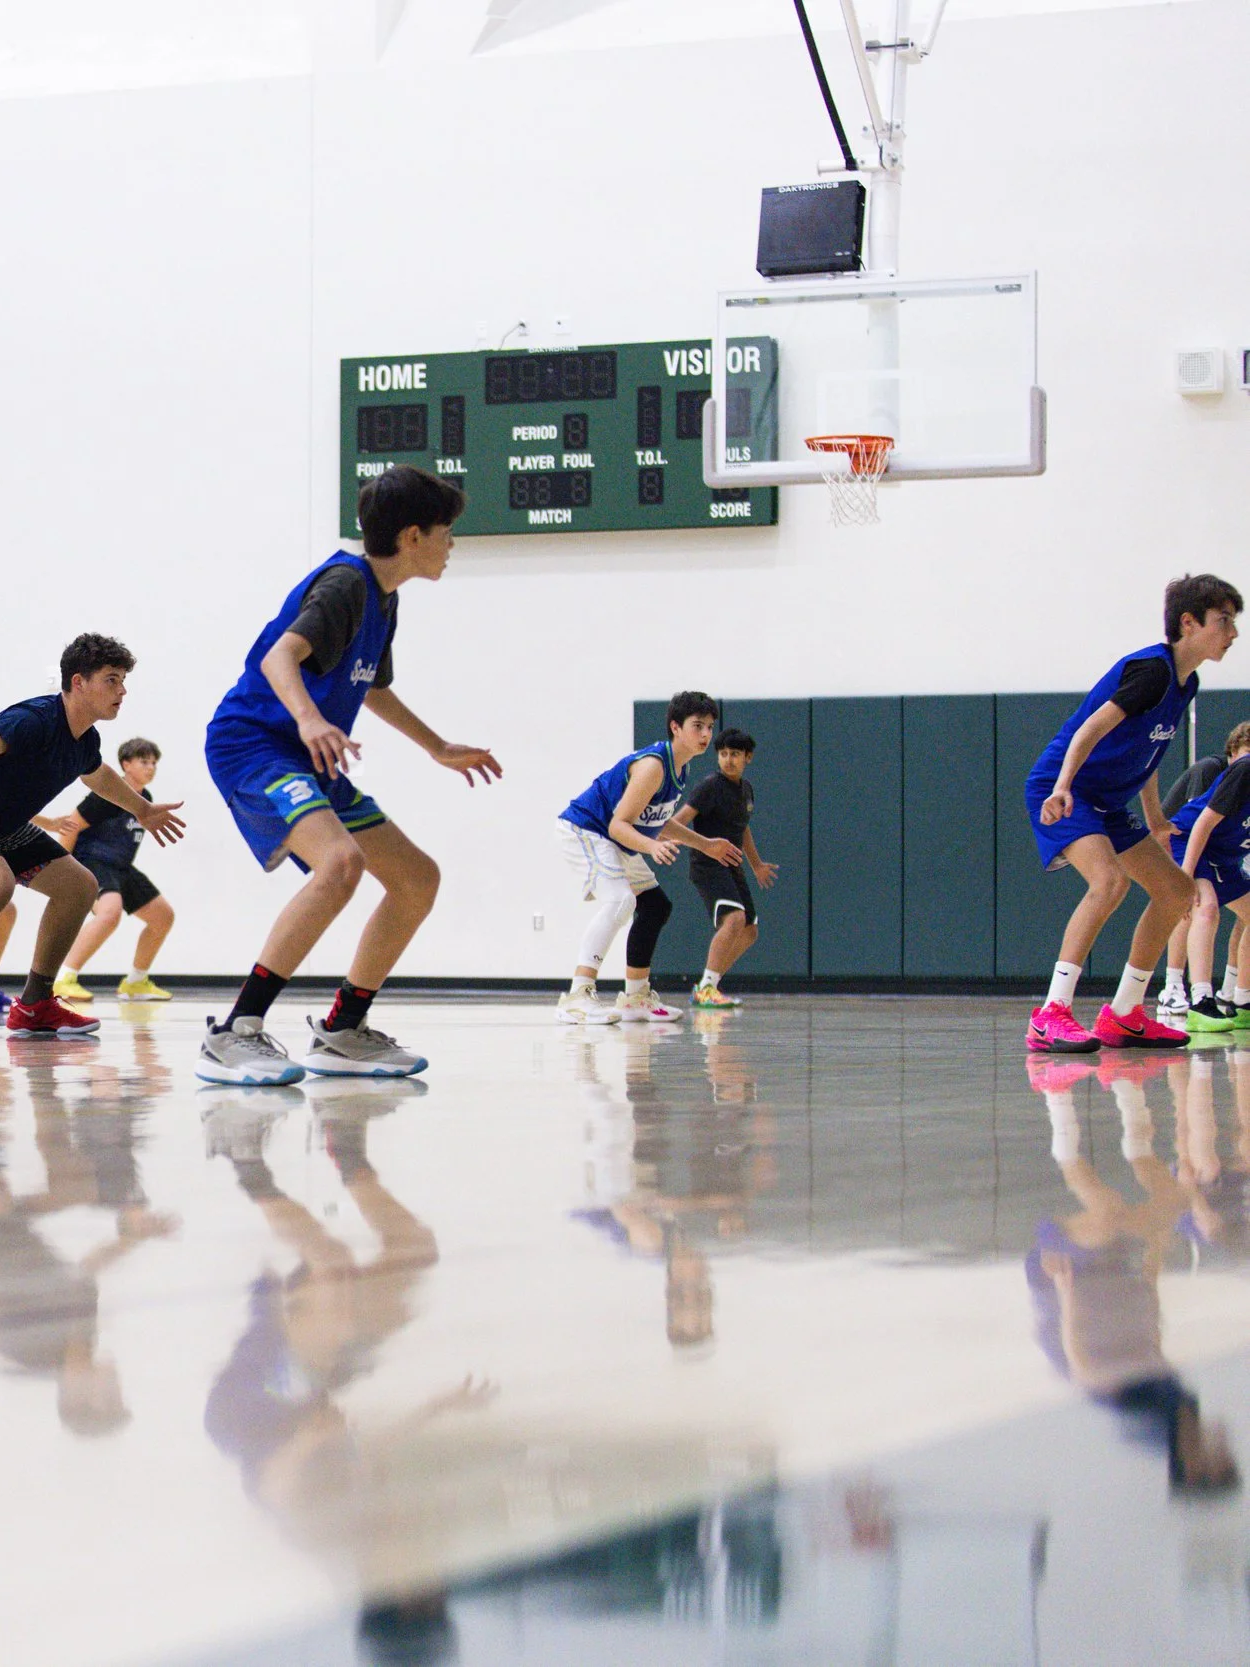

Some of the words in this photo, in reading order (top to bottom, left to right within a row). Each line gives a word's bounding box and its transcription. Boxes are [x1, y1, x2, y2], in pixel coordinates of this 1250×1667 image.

[778, 182, 839, 193] DAKTRONICS
[663, 346, 761, 376] VISIOR
[358, 363, 427, 392] HOME
[512, 425, 558, 441] PERIOD
[508, 455, 555, 470] PLAYER
[562, 453, 595, 468] FOUL
[635, 451, 668, 465] T.O.L.
[726, 447, 751, 462] ULS
[436, 459, 468, 474] T.O.L.
[528, 509, 572, 524] MATCH
[709, 502, 751, 518] SCORE
